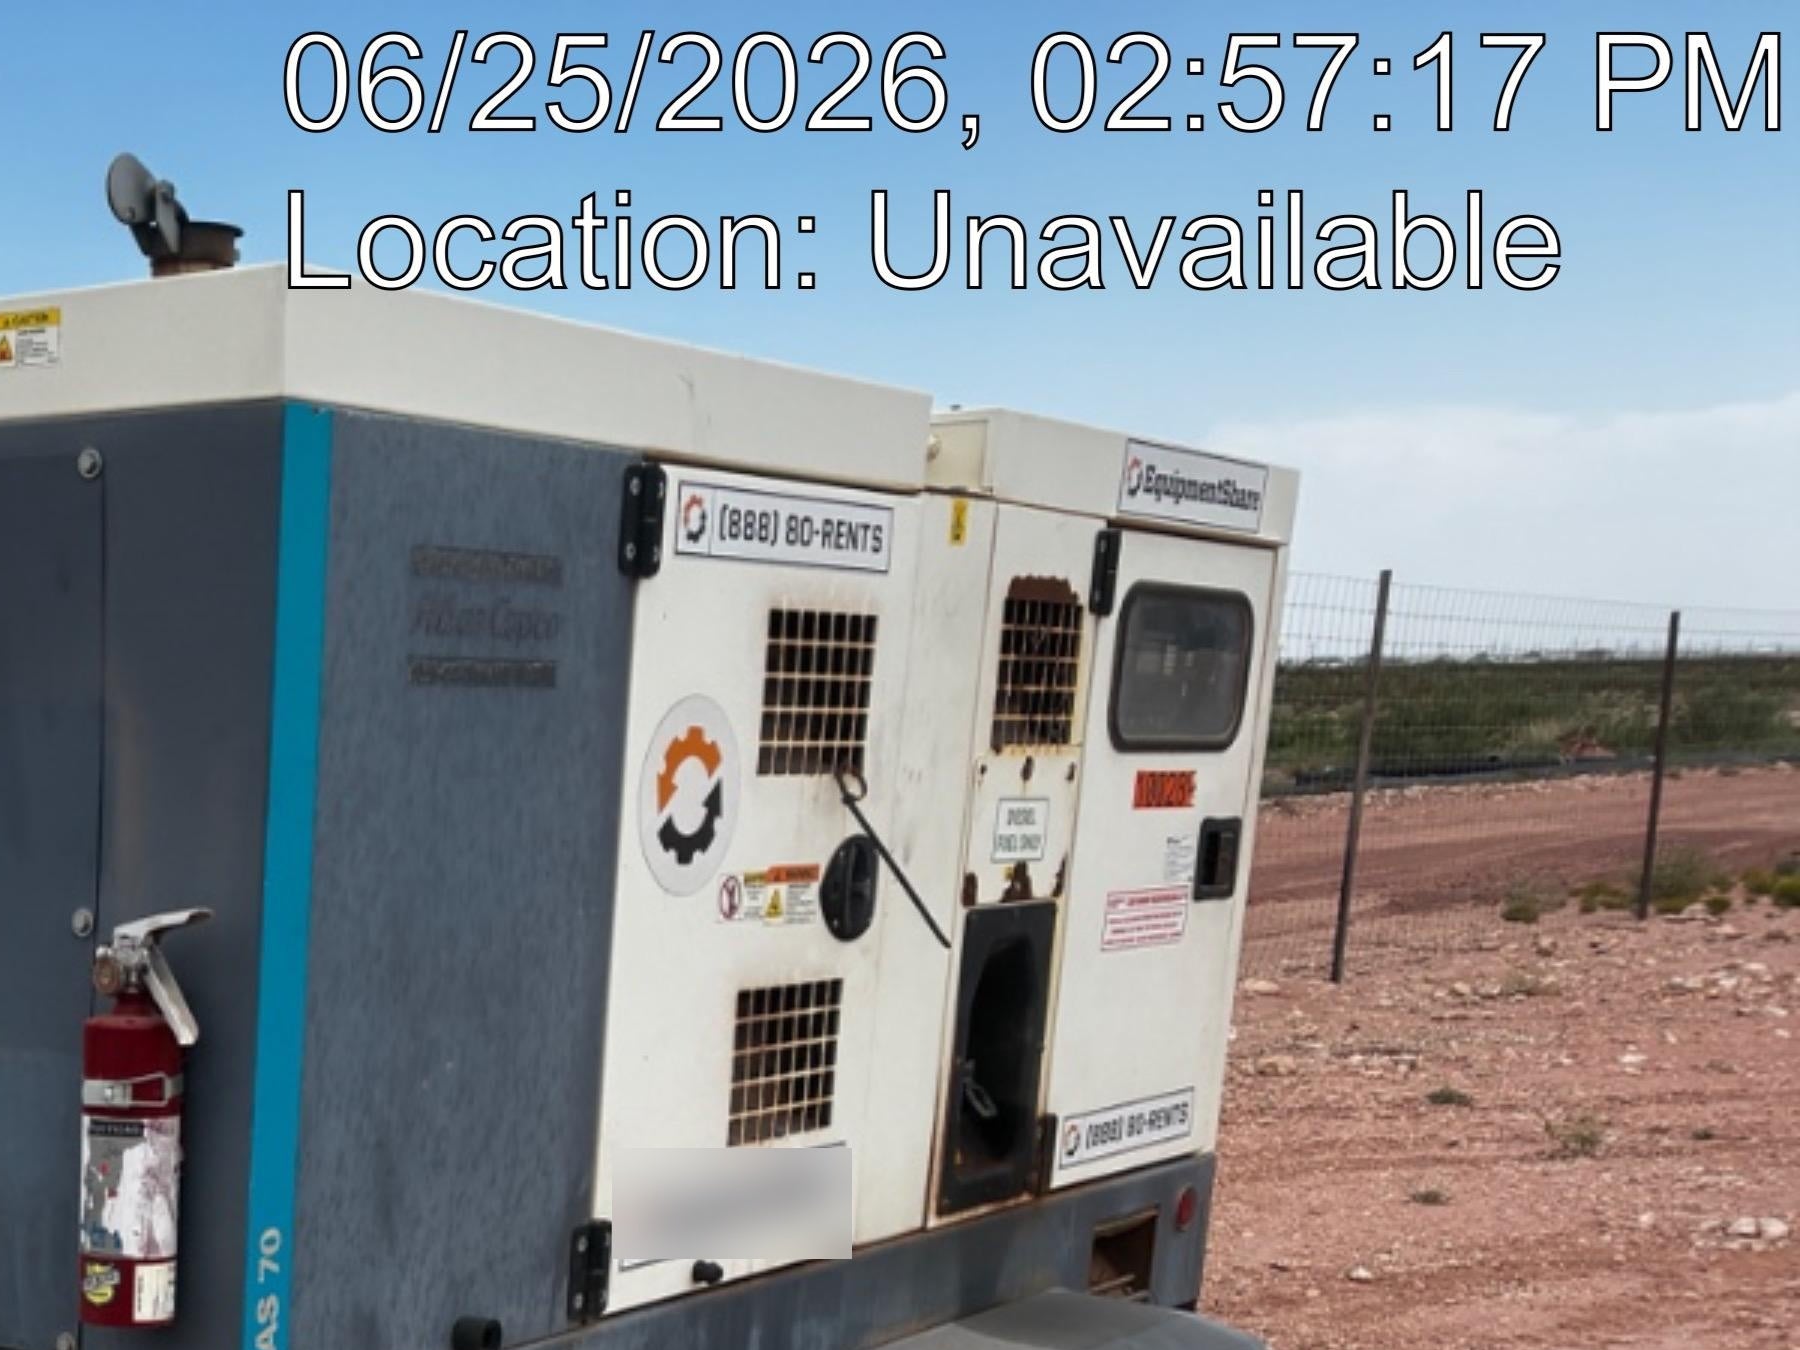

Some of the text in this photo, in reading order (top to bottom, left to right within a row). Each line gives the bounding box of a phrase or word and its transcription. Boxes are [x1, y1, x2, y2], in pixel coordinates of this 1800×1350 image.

[1142, 463, 1261, 512] EquipmentShare
[718, 503, 884, 554] (888) 80-RENTS
[257, 1226, 282, 1284] 70
